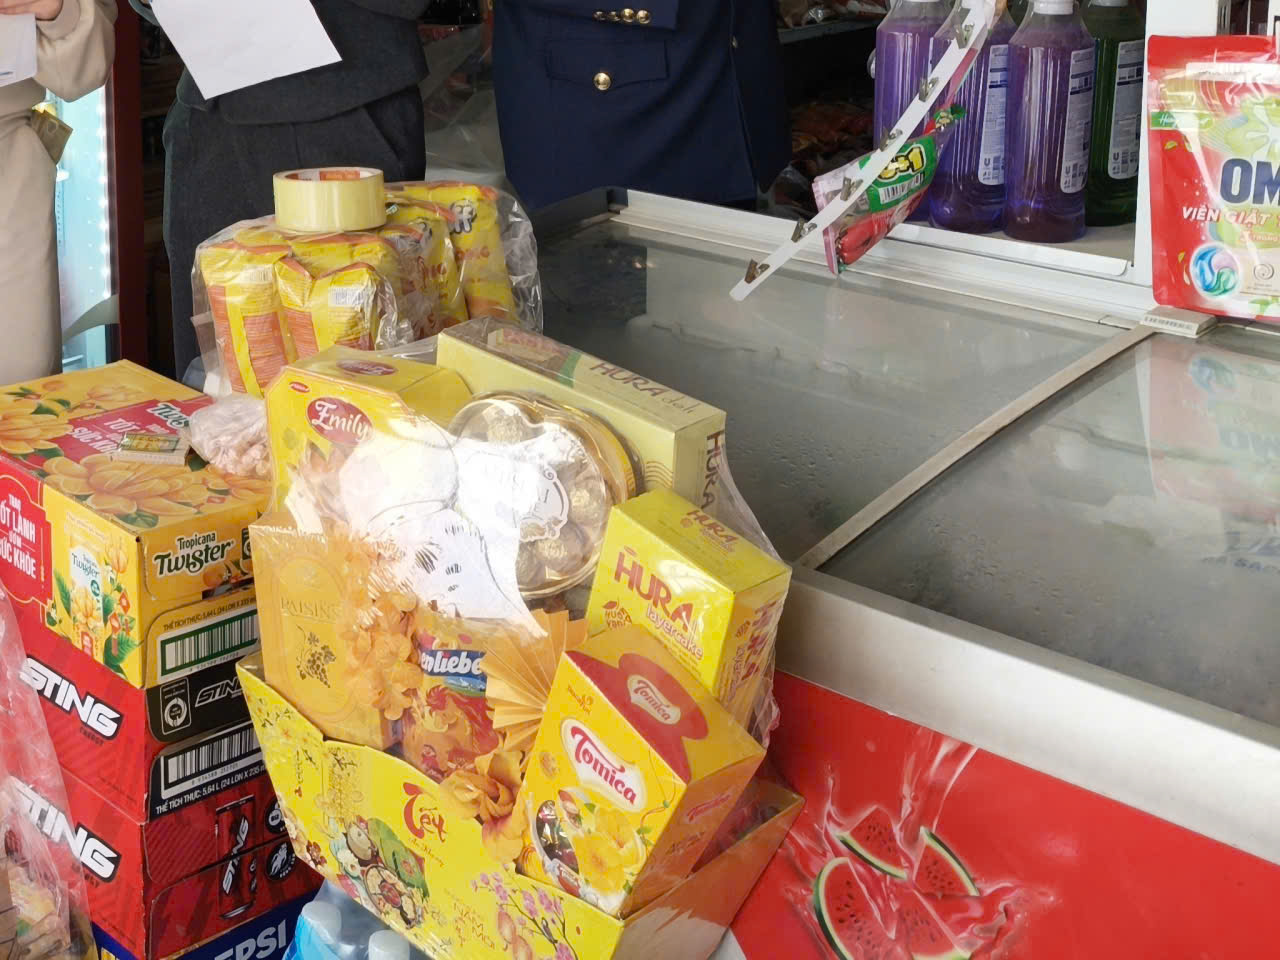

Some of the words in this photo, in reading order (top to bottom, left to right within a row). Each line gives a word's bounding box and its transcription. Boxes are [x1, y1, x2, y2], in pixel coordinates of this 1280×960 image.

[1219, 157, 1280, 205] OM
[590, 361, 667, 397] HURA
[151, 402, 190, 429] Twis
[311, 400, 371, 441] Emily
[154, 540, 231, 575] Twister
[178, 532, 216, 549] Tropicana
[614, 551, 694, 633] HURA
[646, 603, 704, 661] layercake
[420, 649, 482, 675] enliebe
[19, 656, 121, 738] STING
[632, 678, 672, 722] Tomica
[570, 725, 637, 806] Tomica
[222, 816, 249, 894] STING
[214, 919, 287, 960] EPSI
